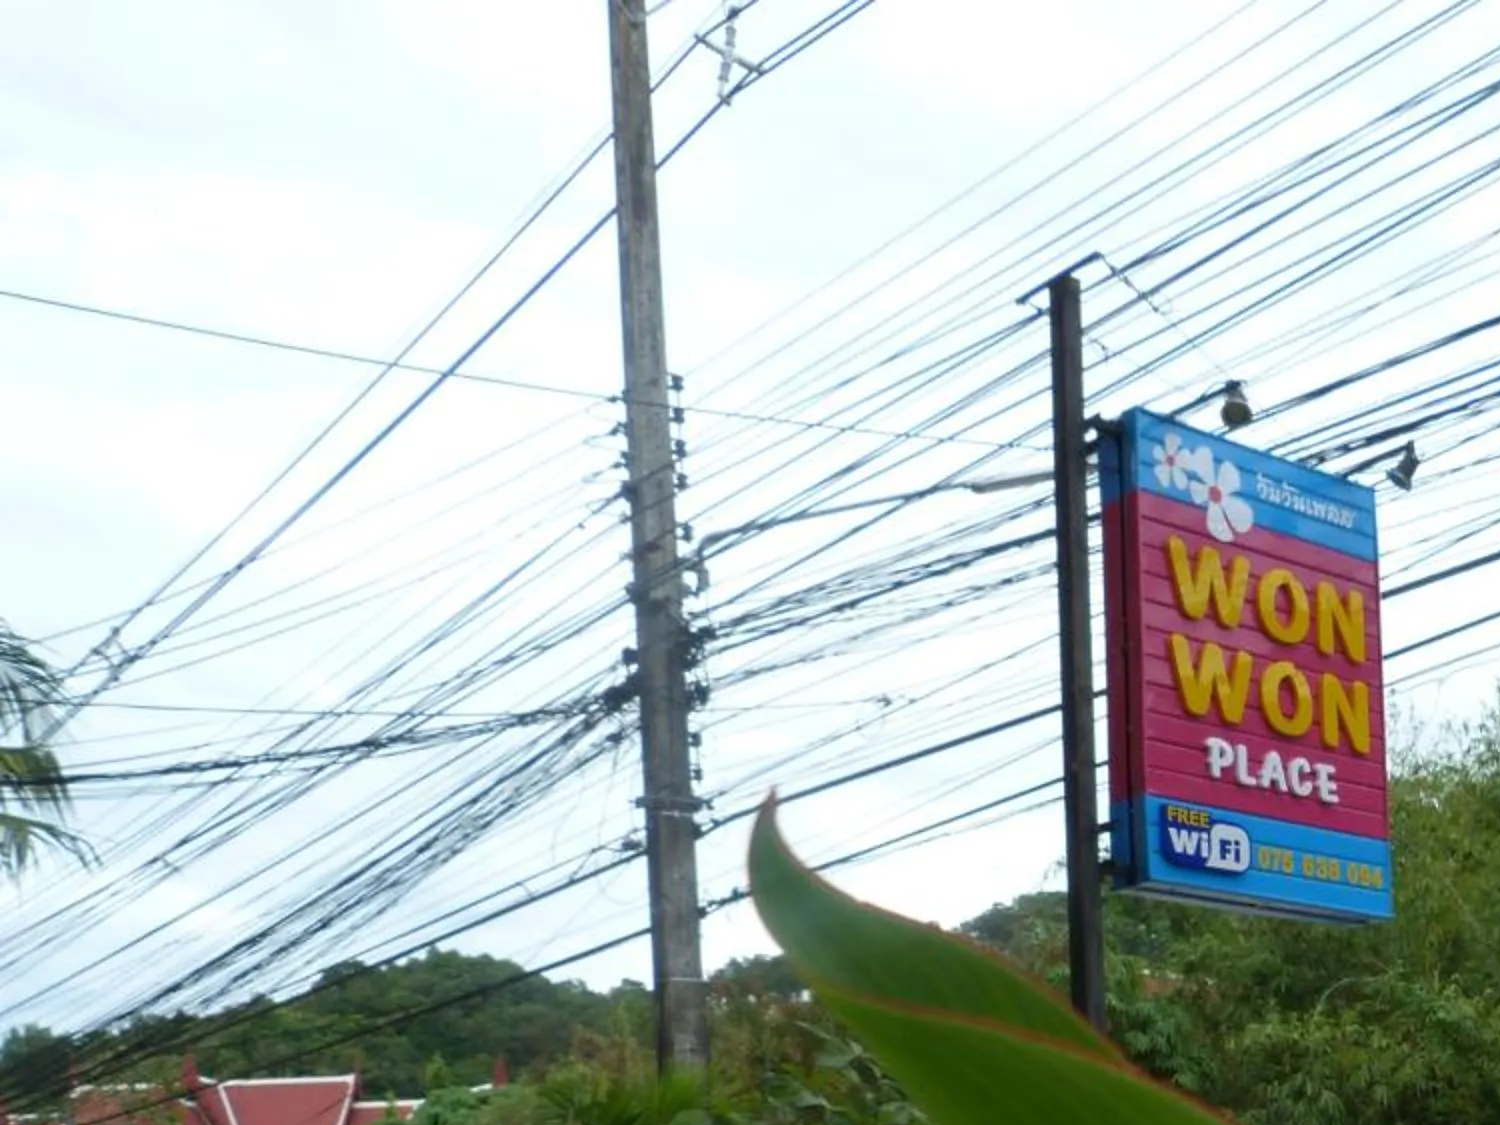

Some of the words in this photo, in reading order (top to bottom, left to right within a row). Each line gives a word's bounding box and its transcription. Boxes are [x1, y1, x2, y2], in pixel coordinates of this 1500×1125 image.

[1168, 534, 1366, 664] WON
[1169, 633, 1371, 754] WON
[1205, 737, 1339, 803] PLACE
[1167, 805, 1210, 829] FREE
